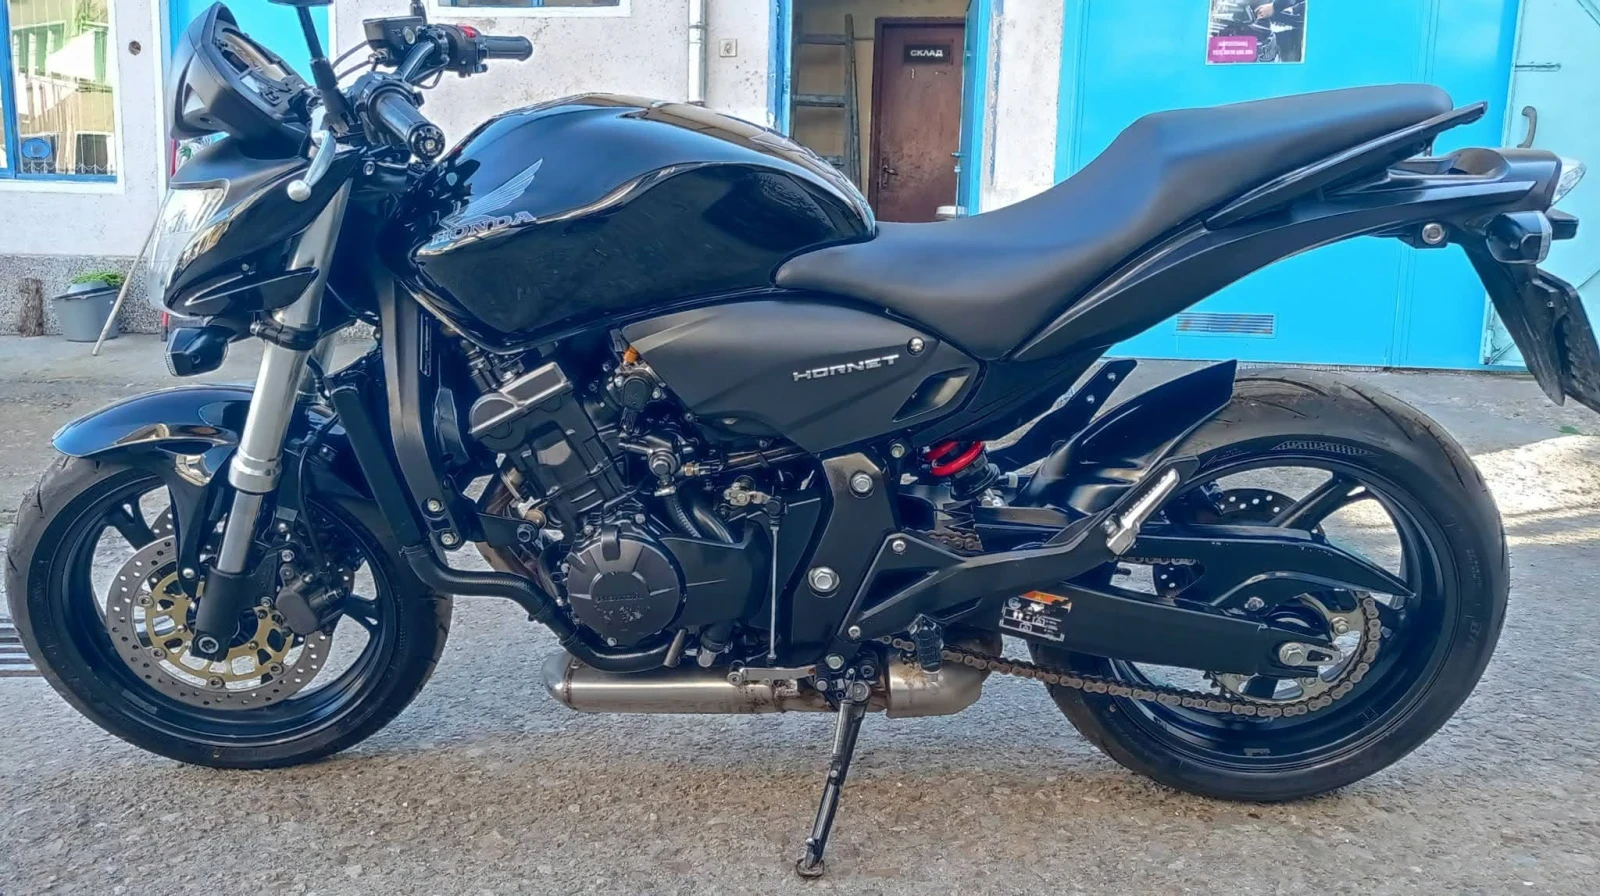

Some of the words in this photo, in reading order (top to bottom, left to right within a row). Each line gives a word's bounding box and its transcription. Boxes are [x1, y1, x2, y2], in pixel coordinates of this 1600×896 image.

[910, 49, 943, 57] СКЛАД
[431, 210, 537, 246] HONDA
[792, 354, 899, 382] HORNET
